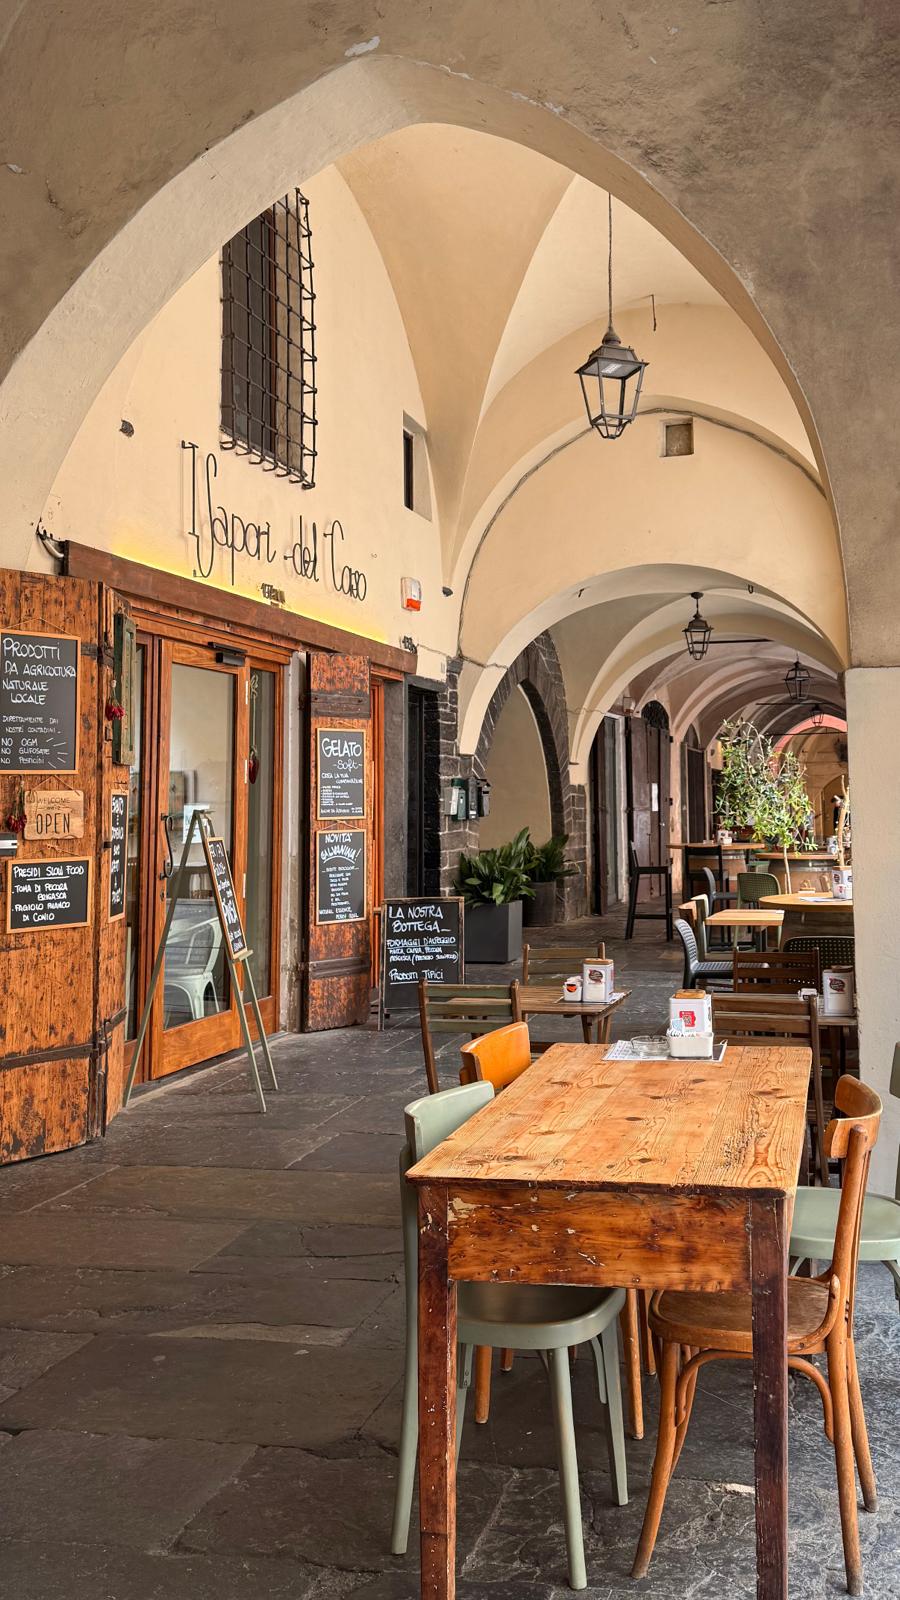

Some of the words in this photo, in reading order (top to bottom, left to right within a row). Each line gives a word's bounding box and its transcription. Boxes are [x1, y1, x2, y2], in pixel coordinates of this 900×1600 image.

[196, 453, 276, 586] Sapori
[290, 515, 319, 582] del
[5, 661, 18, 676] DA
[2, 680, 48, 692] NATURALE
[10, 693, 46, 705] LOCALE
[2, 715, 43, 723] DIRETTAMENTE
[1, 738, 13, 747] NO
[21, 738, 38, 747] OGM
[321, 737, 362, 758] GELATO
[1, 747, 11, 755] NO
[36, 813, 70, 834] OPEN
[13, 866, 41, 878] PRESIDI
[46, 865, 64, 877] SLOW
[66, 865, 84, 875] FOOD
[14, 884, 32, 893] TOMA
[34, 883, 41, 893] DI
[44, 882, 68, 892] PECORA
[14, 903, 44, 912] FAGIOLO
[388, 905, 405, 919] LA
[407, 904, 444, 919] NOSTRA
[22, 914, 30, 922] DI
[33, 912, 55, 922] CONIO
[391, 920, 440, 933] BOTTEGA
[387, 938, 420, 947] FORMAGGI
